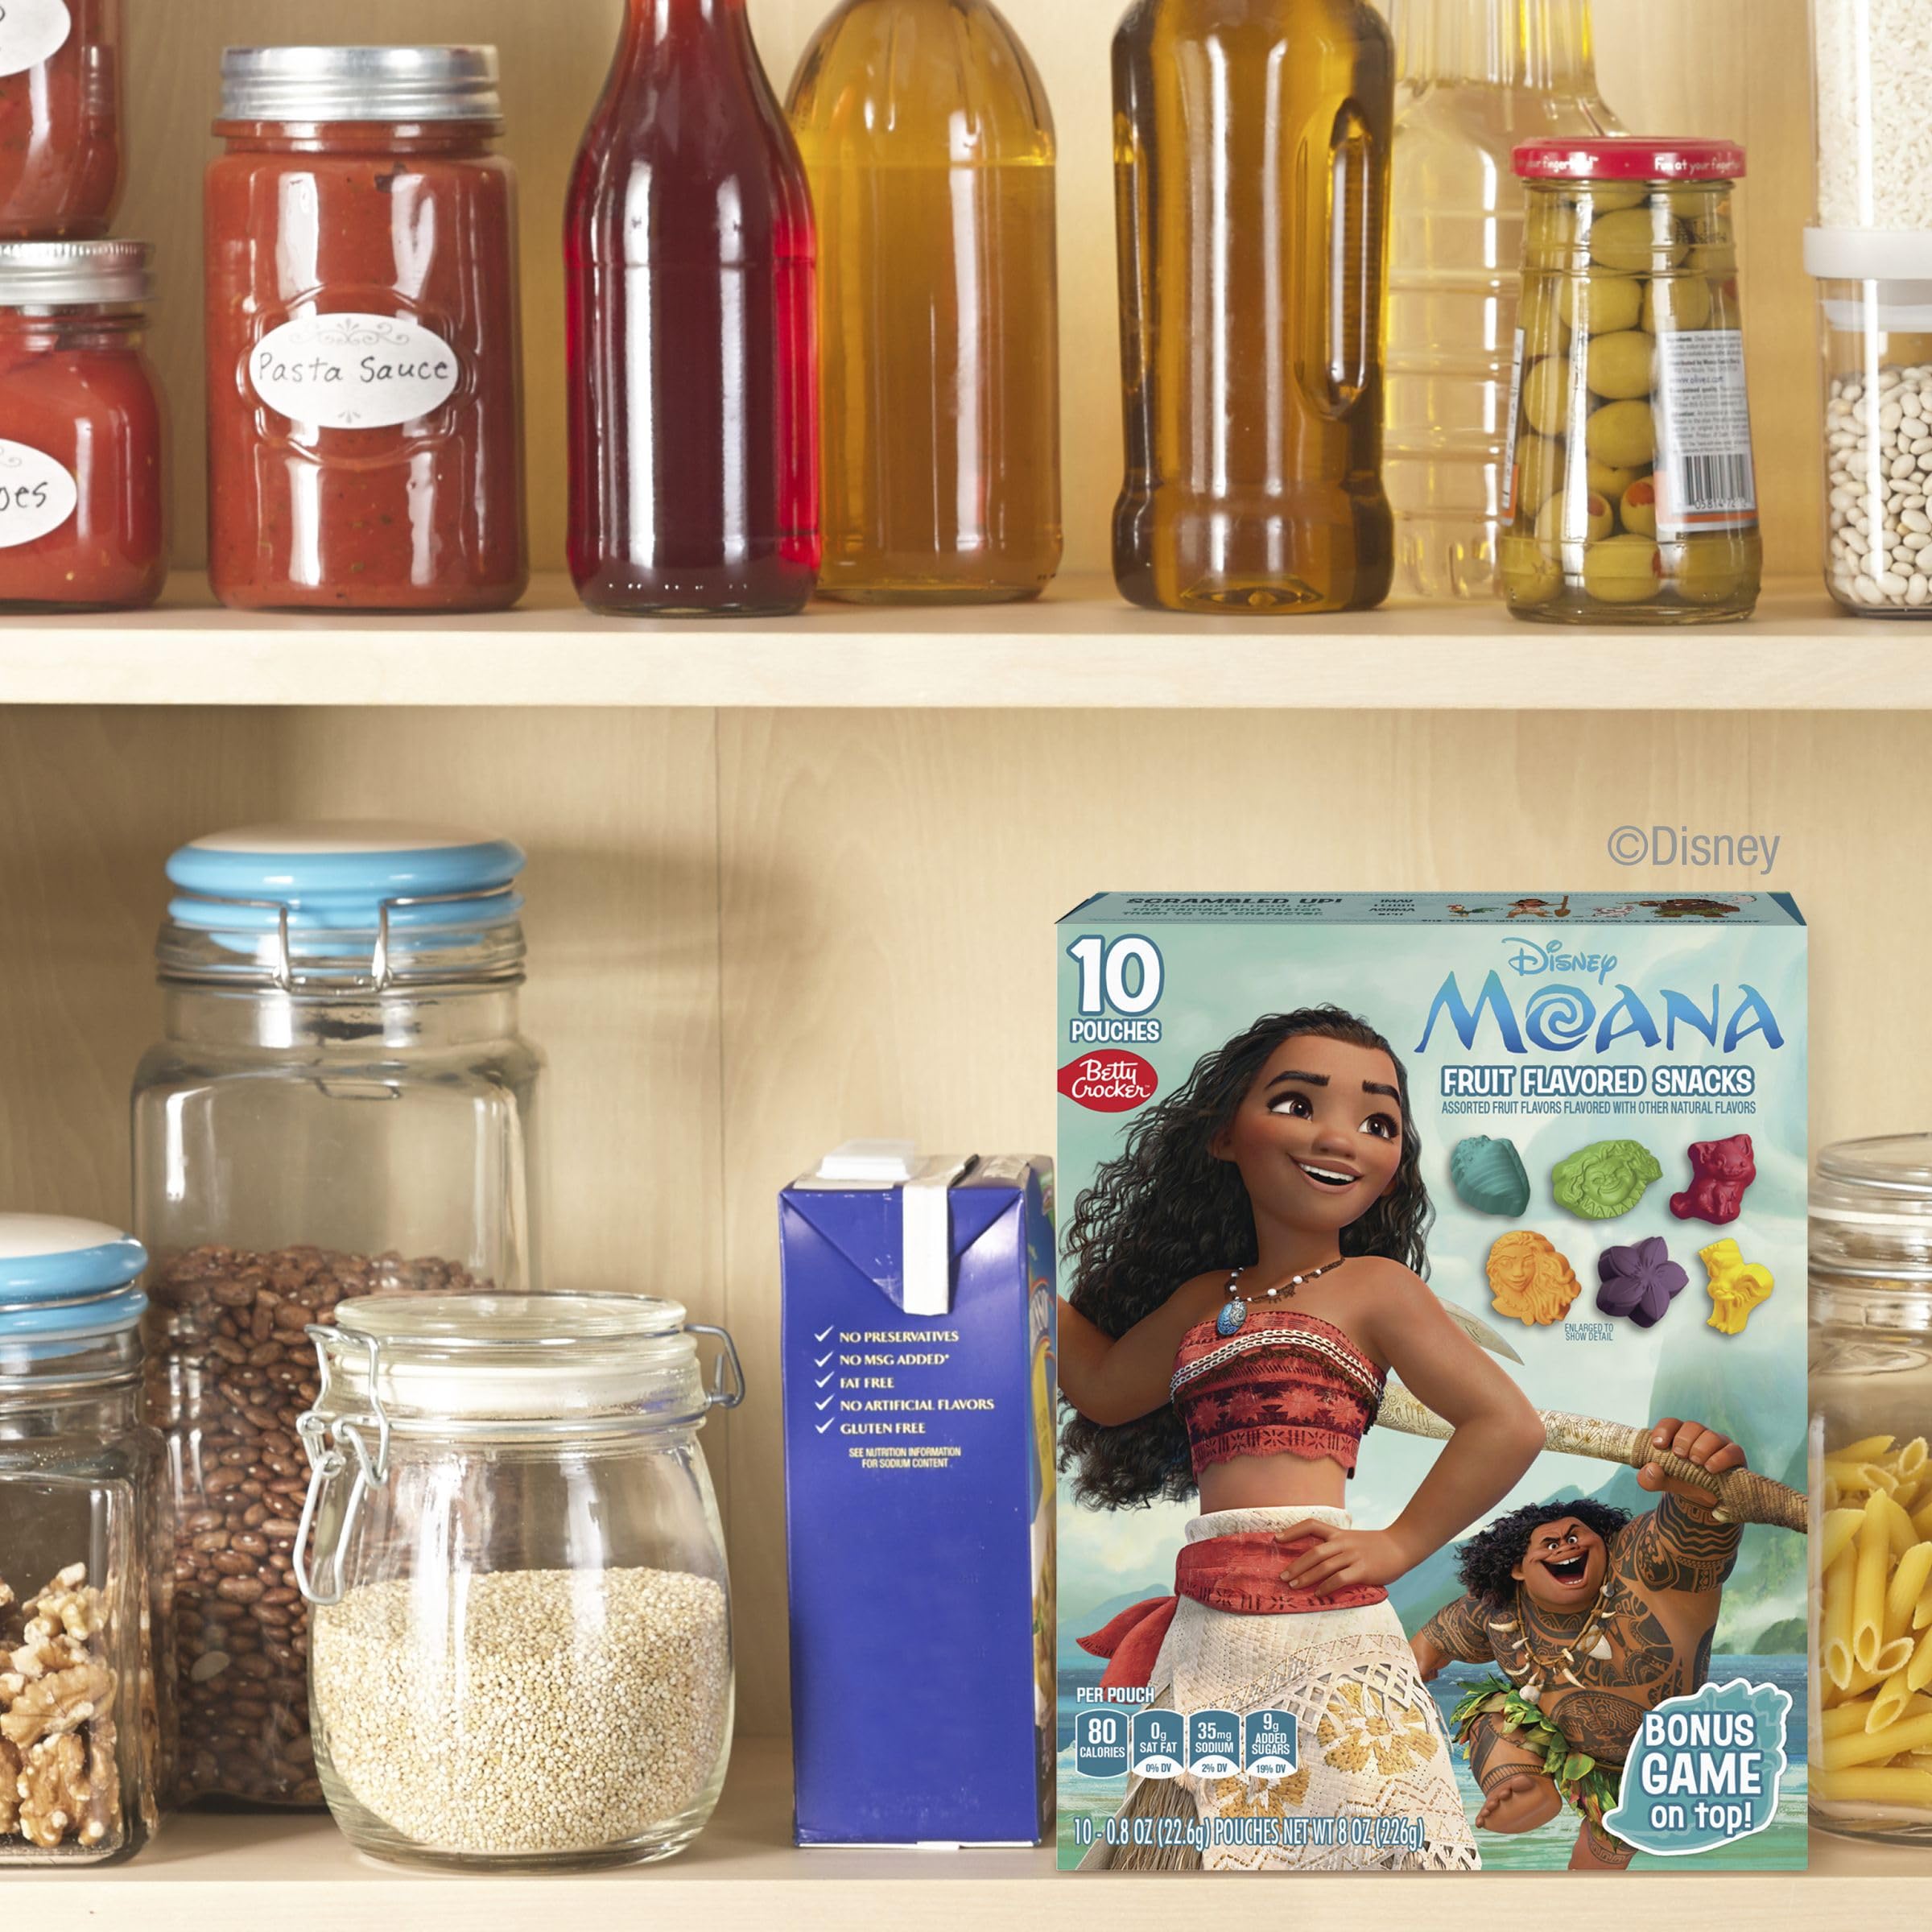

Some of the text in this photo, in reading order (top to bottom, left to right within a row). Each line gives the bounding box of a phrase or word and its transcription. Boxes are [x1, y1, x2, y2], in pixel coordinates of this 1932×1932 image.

[1674, 159, 1687, 171] at
[1690, 163, 1710, 175] your
[259, 352, 449, 383] Pasta Sauce
[1501, 936, 1618, 985] Disney
[1067, 934, 1164, 1016] 10
[1414, 969, 1785, 1054] MOANA
[1071, 1019, 1162, 1042] POUCHES
[1080, 1059, 1138, 1085] Betty
[1443, 1067, 1754, 1096] FRUIT FLAVORED SNACKS
[1441, 1100, 1757, 1114] ASSORTED FRUIT FLAVORS FLAVORED WITH OTHER NATURAL FLAVORS
[1564, 1323, 1614, 1332] ENLARGED TO
[839, 1331, 960, 1343] NO PRESERVATIVES
[1565, 1331, 1614, 1341] SHOW DETAIL
[839, 1354, 861, 1365] NO
[864, 1354, 894, 1365] MSG
[840, 1377, 895, 1389] FAT FREE
[840, 1398, 995, 1411] NO ARTIFICIAL FLAVORS
[840, 1422, 926, 1435] GLUTEN FREE
[848, 1447, 961, 1458] SEE NUTRITION INFORMATION
[861, 1458, 948, 1468] FOR SODIUM CONTENT
[1075, 1686, 1155, 1703] PER POUCH
[1262, 1712, 1279, 1733] 9g
[1088, 1717, 1117, 1745] 80
[1150, 1721, 1167, 1742] 0g
[1197, 1721, 1232, 1742] 35mg
[1644, 1712, 1756, 1748] BONUS
[1255, 1732, 1287, 1744] ADDED
[1080, 1746, 1125, 1758] CALORIES
[1139, 1741, 1178, 1753] SAT FAT
[1195, 1741, 1234, 1753] SODIUM
[1251, 1744, 1290, 1755] SUGARS
[1146, 1763, 1172, 1773] 0% DV
[1201, 1763, 1228, 1773] 2% DV
[1256, 1764, 1286, 1773] 19% DV
[1640, 1751, 1763, 1796] GAME
[1649, 1800, 1753, 1836] on top!
[1074, 1817, 1092, 1845] 10
[1105, 1817, 1129, 1845] 0.8
[1133, 1817, 1154, 1845] OZ
[1158, 1817, 1212, 1852] (22.6g)
[1214, 1817, 1280, 1845] POUCHES
[1282, 1817, 1311, 1845] NET
[1312, 1817, 1335, 1845] WT
[1337, 1817, 1348, 1845] 8
[1351, 1817, 1373, 1845] OZ
[1375, 1817, 1425, 1852] (226g)
